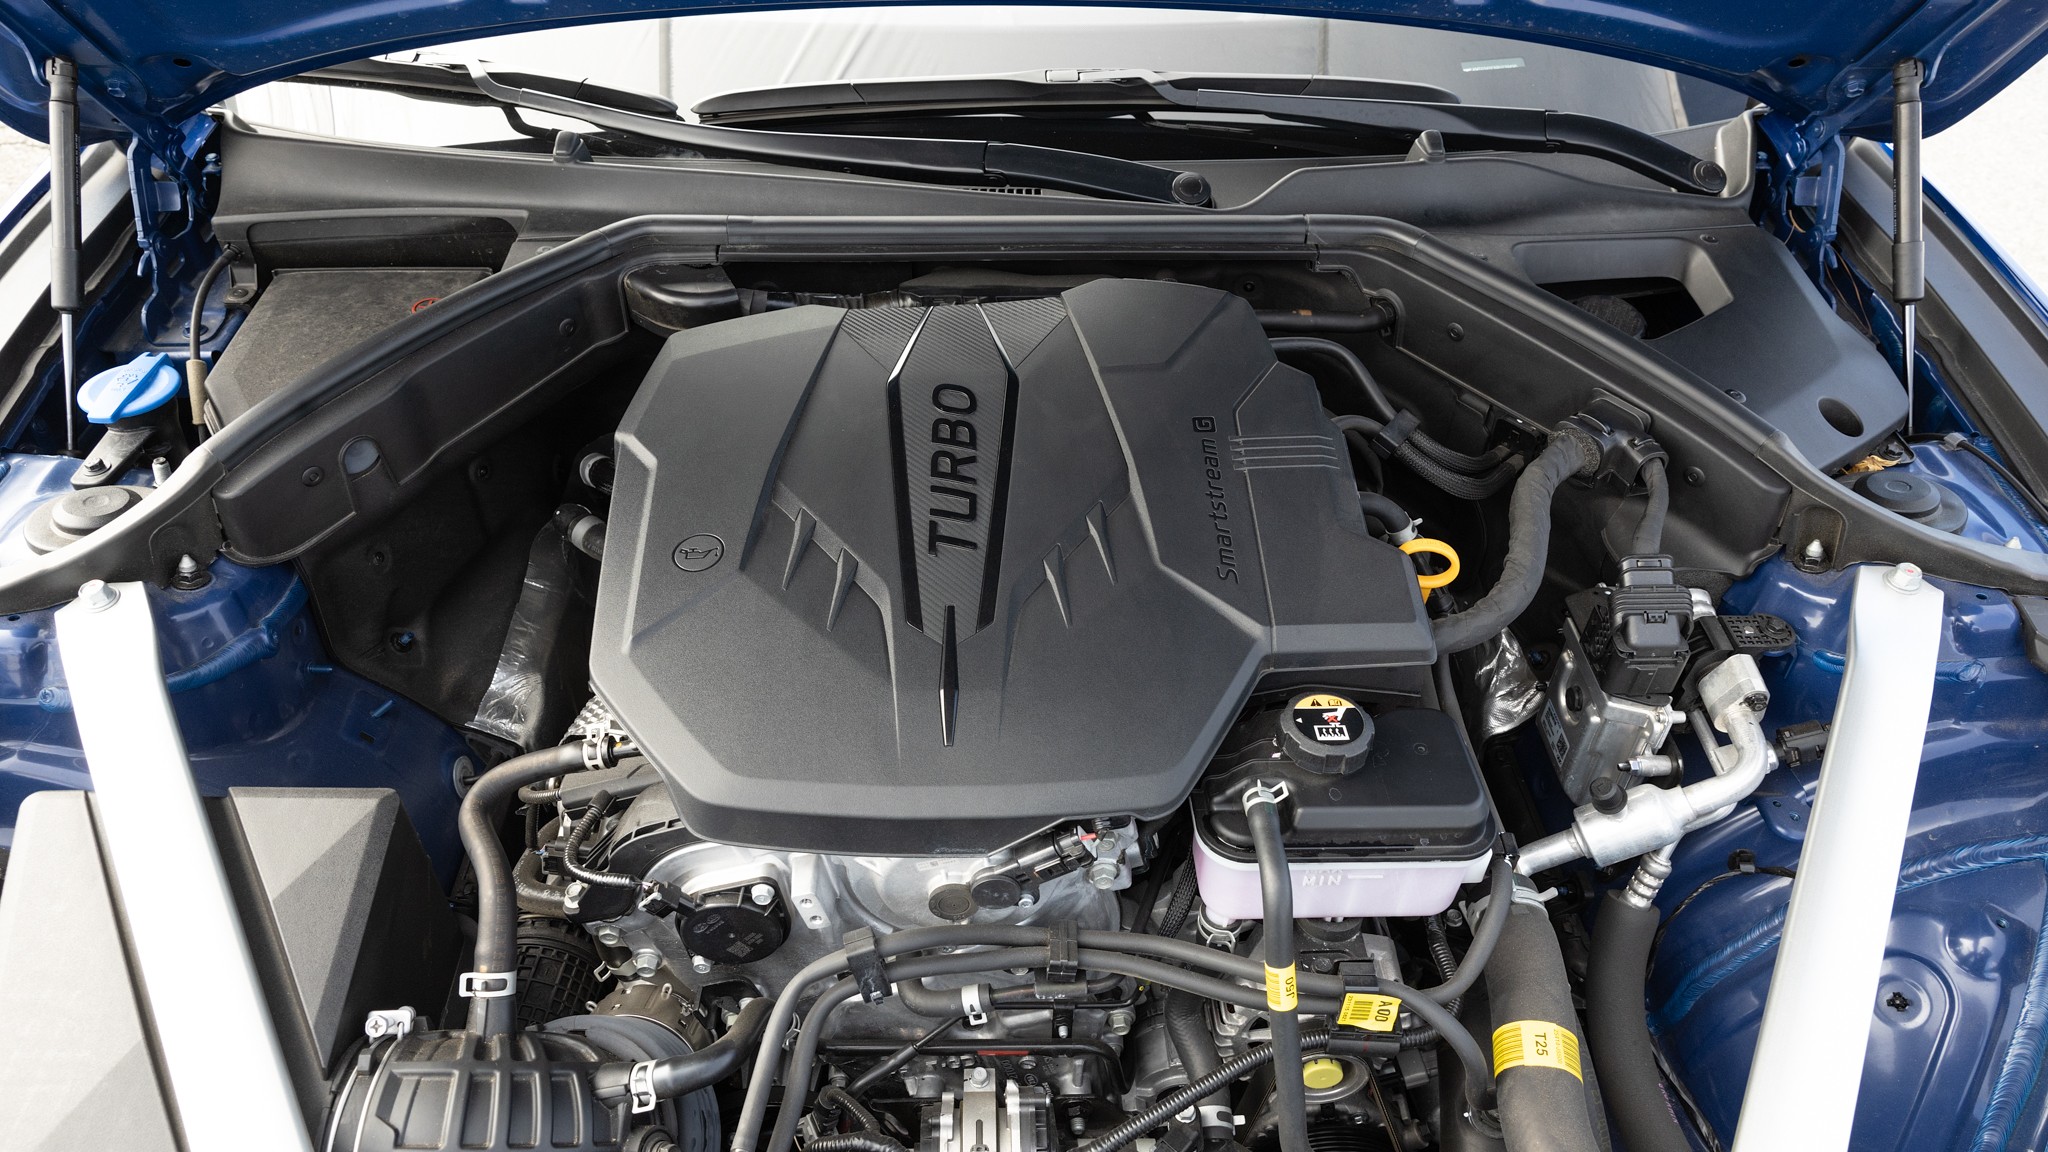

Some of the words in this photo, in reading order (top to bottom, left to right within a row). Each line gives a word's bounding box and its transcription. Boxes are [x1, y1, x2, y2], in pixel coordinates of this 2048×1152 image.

[1192, 415, 1216, 433] G
[928, 383, 977, 556] TURBO
[1203, 438, 1239, 584] Smartstream
[1303, 875, 1341, 887] MIN
[1535, 1032, 1549, 1055] T25
